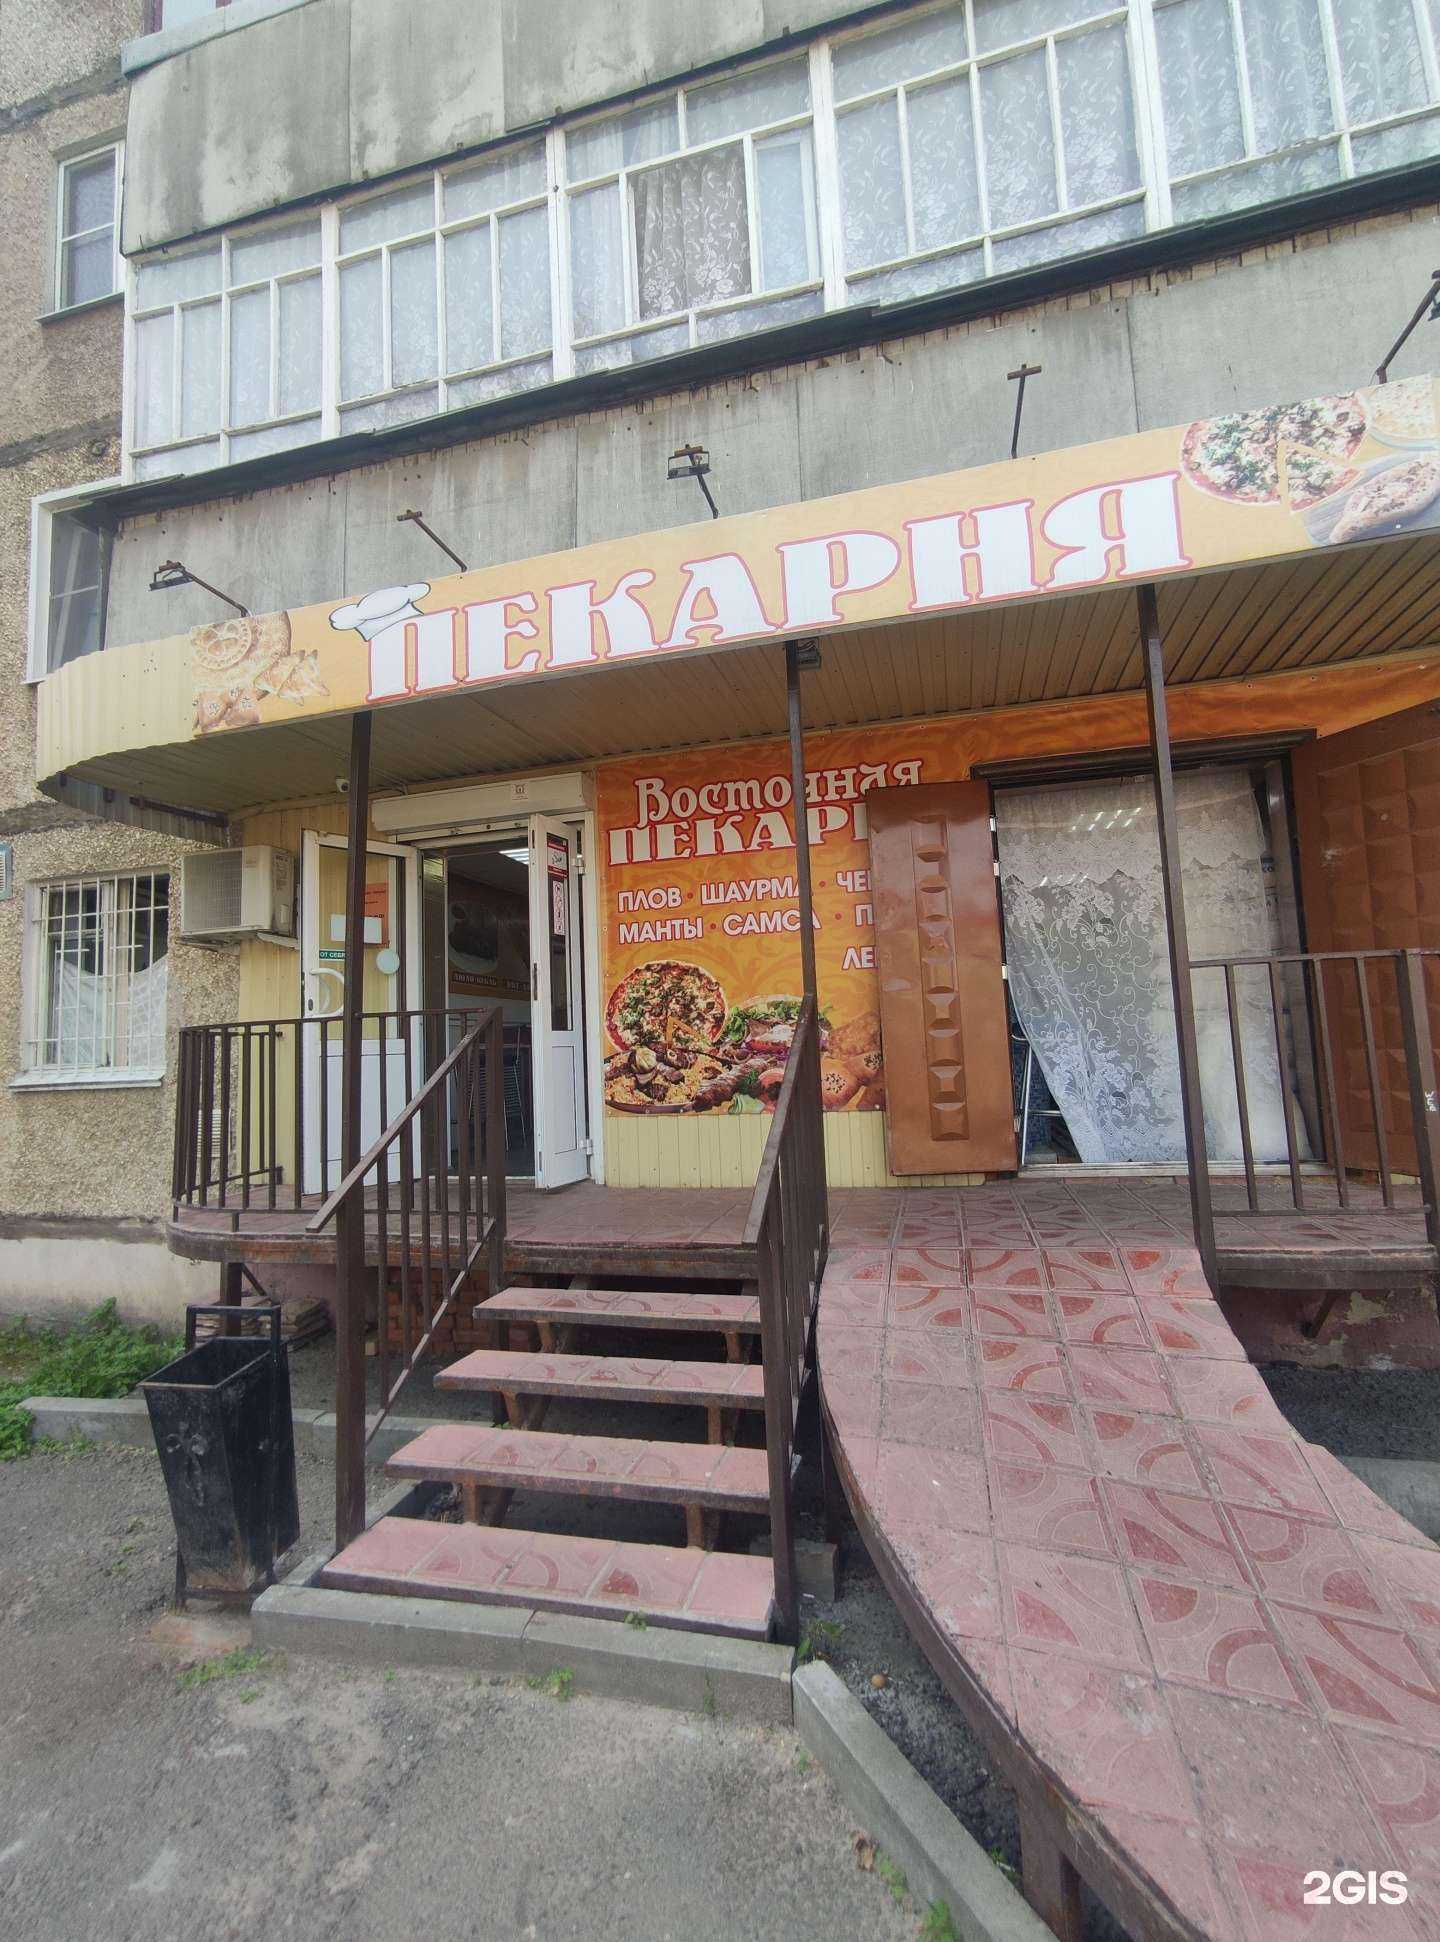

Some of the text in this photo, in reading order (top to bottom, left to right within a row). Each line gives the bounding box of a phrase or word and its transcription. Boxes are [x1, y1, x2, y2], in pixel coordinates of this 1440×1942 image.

[366, 470, 1191, 703] ПЕКАРНЯ
[617, 869, 872, 913] ПЛОВ ШАУРМ ЧЕ
[618, 917, 704, 944] МАНТЫ
